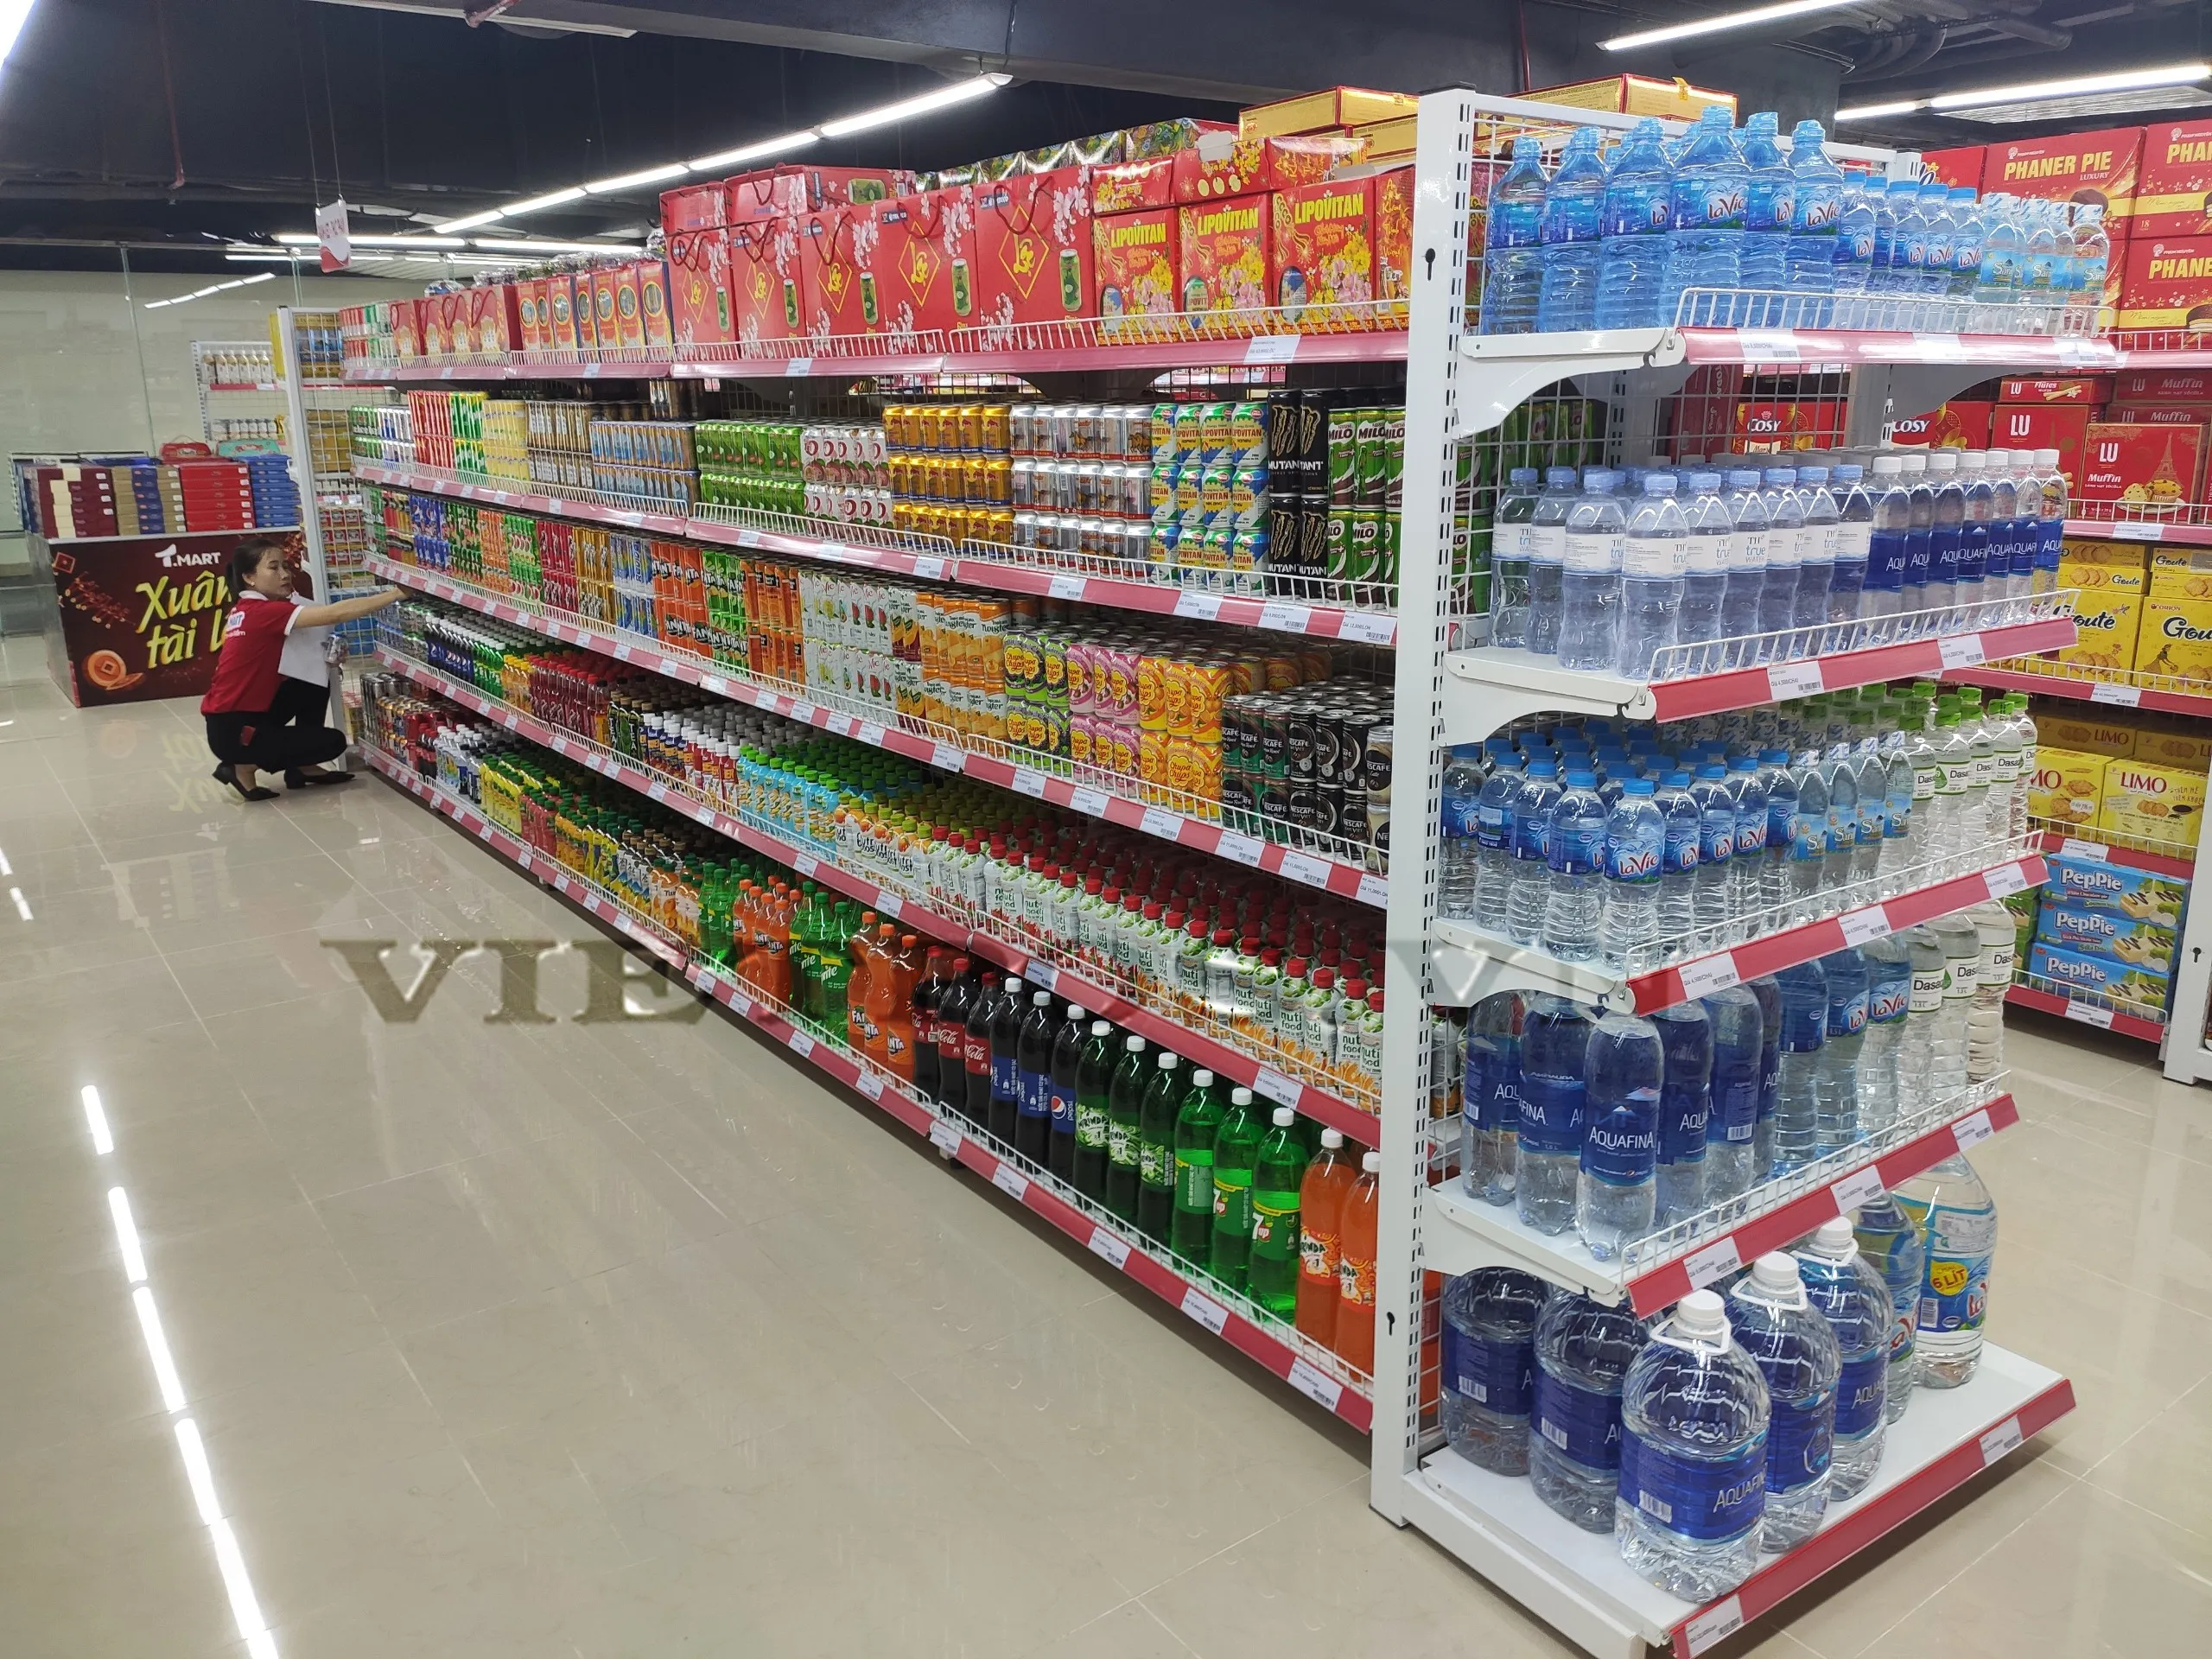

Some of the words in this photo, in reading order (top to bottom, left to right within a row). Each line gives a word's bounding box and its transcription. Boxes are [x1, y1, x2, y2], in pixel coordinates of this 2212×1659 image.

[2003, 156, 2076, 181] PHANER
[2081, 151, 2113, 172] PIE
[2079, 172, 2109, 181] LUXURY
[1295, 193, 1363, 225] LIPOVITAN
[1198, 207, 1258, 235] LIPOVITAN
[1110, 222, 1166, 247] LIPOVITAN
[2010, 382, 2022, 395] LU
[2133, 378, 2145, 391] LU
[2161, 378, 2202, 388] Muffin
[1748, 418, 1782, 432] COSY
[2010, 415, 2031, 436] LU
[2151, 412, 2191, 423] Muffin
[1358, 428, 1384, 440] MILO
[2100, 443, 2119, 462] LU
[2088, 474, 2121, 483] Muffin
[1746, 545, 1766, 556] true
[147, 618, 198, 669] tài
[2094, 728, 2129, 745] LIMO
[2120, 772, 2166, 793] LIMO
[1281, 1010, 1302, 1021] nuti
[1281, 1020, 1302, 1031] food
[1589, 1126, 1655, 1150] AQUAFINA
[1932, 1277, 1942, 1288] 6
[1943, 1268, 1965, 1286] LÍT
